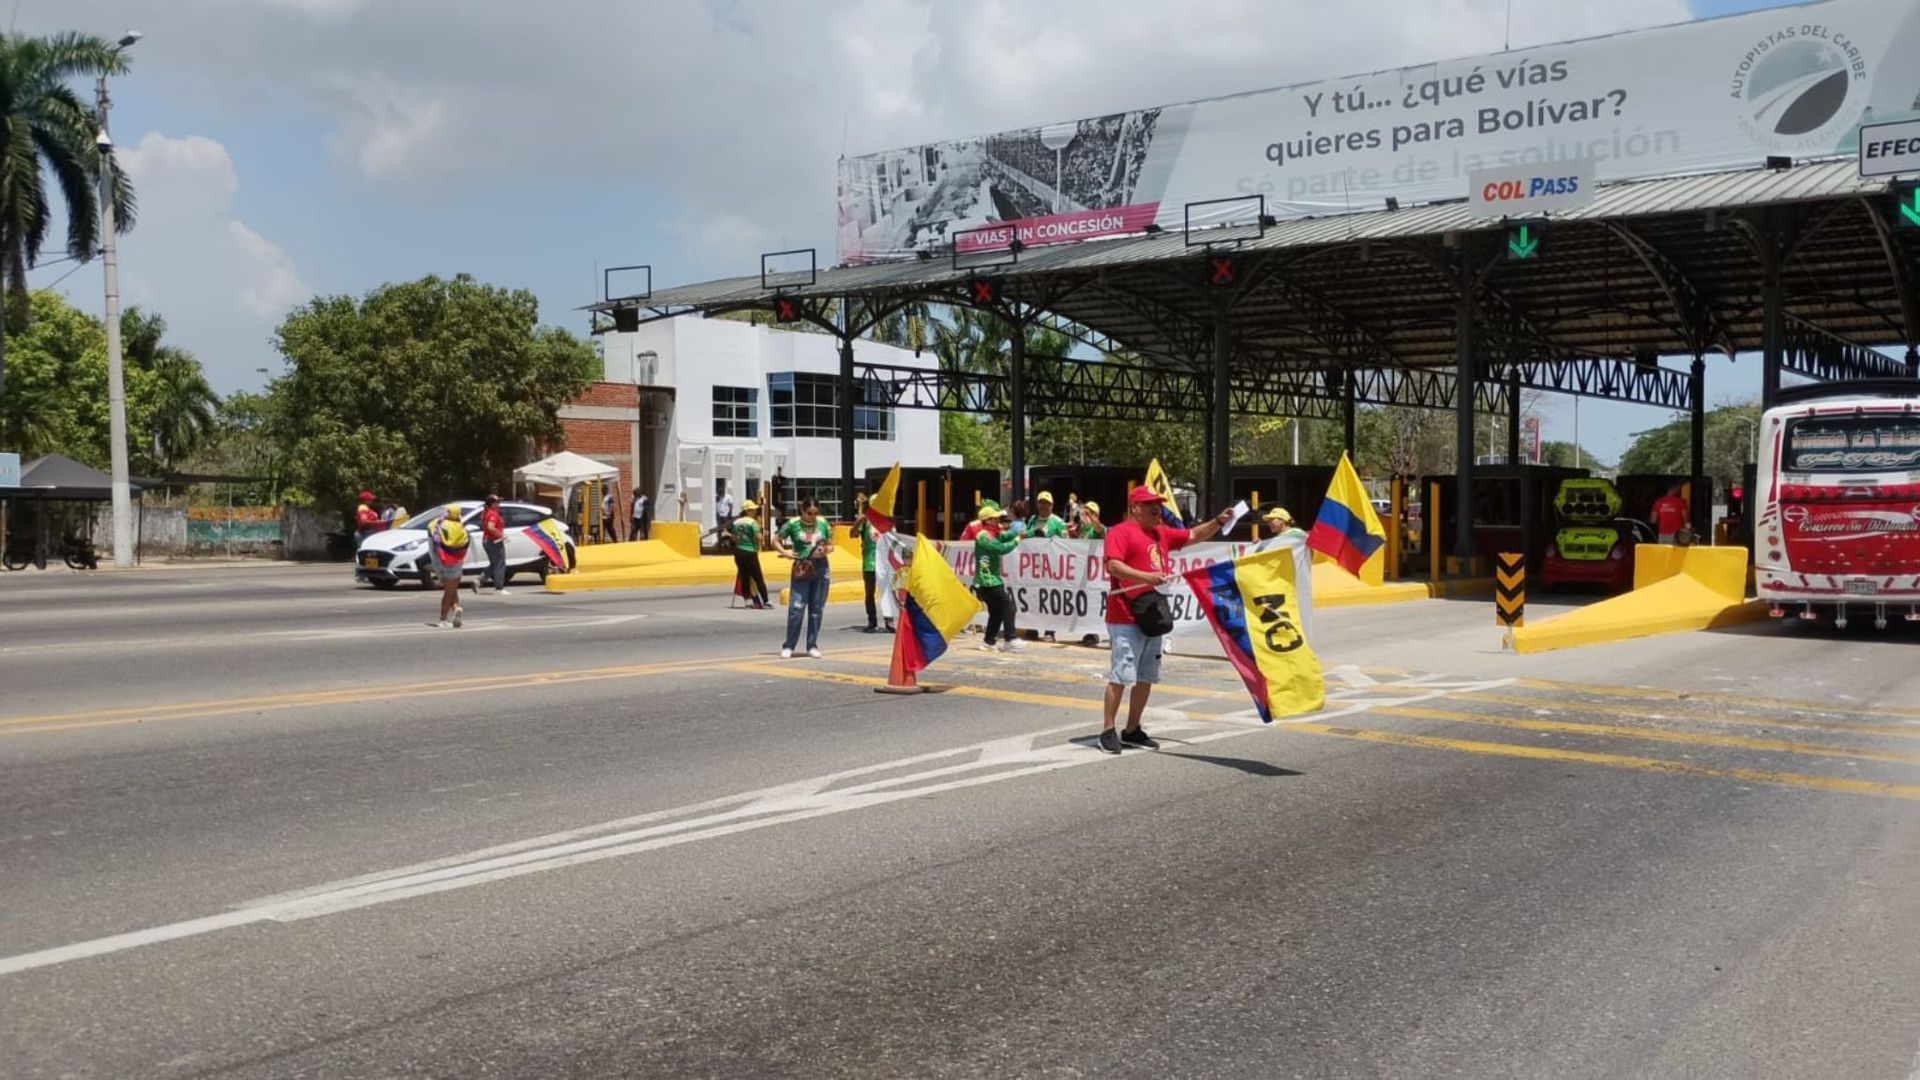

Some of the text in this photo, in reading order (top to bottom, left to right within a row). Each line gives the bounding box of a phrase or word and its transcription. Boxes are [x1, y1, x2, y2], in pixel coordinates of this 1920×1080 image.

[1731, 24, 1867, 99] AUTOPISTAS DEL CARIBE
[1303, 58, 1568, 118] Y tú... ¿qué vías
[1265, 89, 1627, 166] quieres para Bolívar?
[1866, 137, 1920, 159] EFEC
[1392, 155, 1440, 184] de
[1452, 149, 1483, 177] la
[1036, 214, 1123, 238] CONCESIÓN
[1019, 552, 1076, 581] PEAJE
[1039, 588, 1088, 617] ROBO
